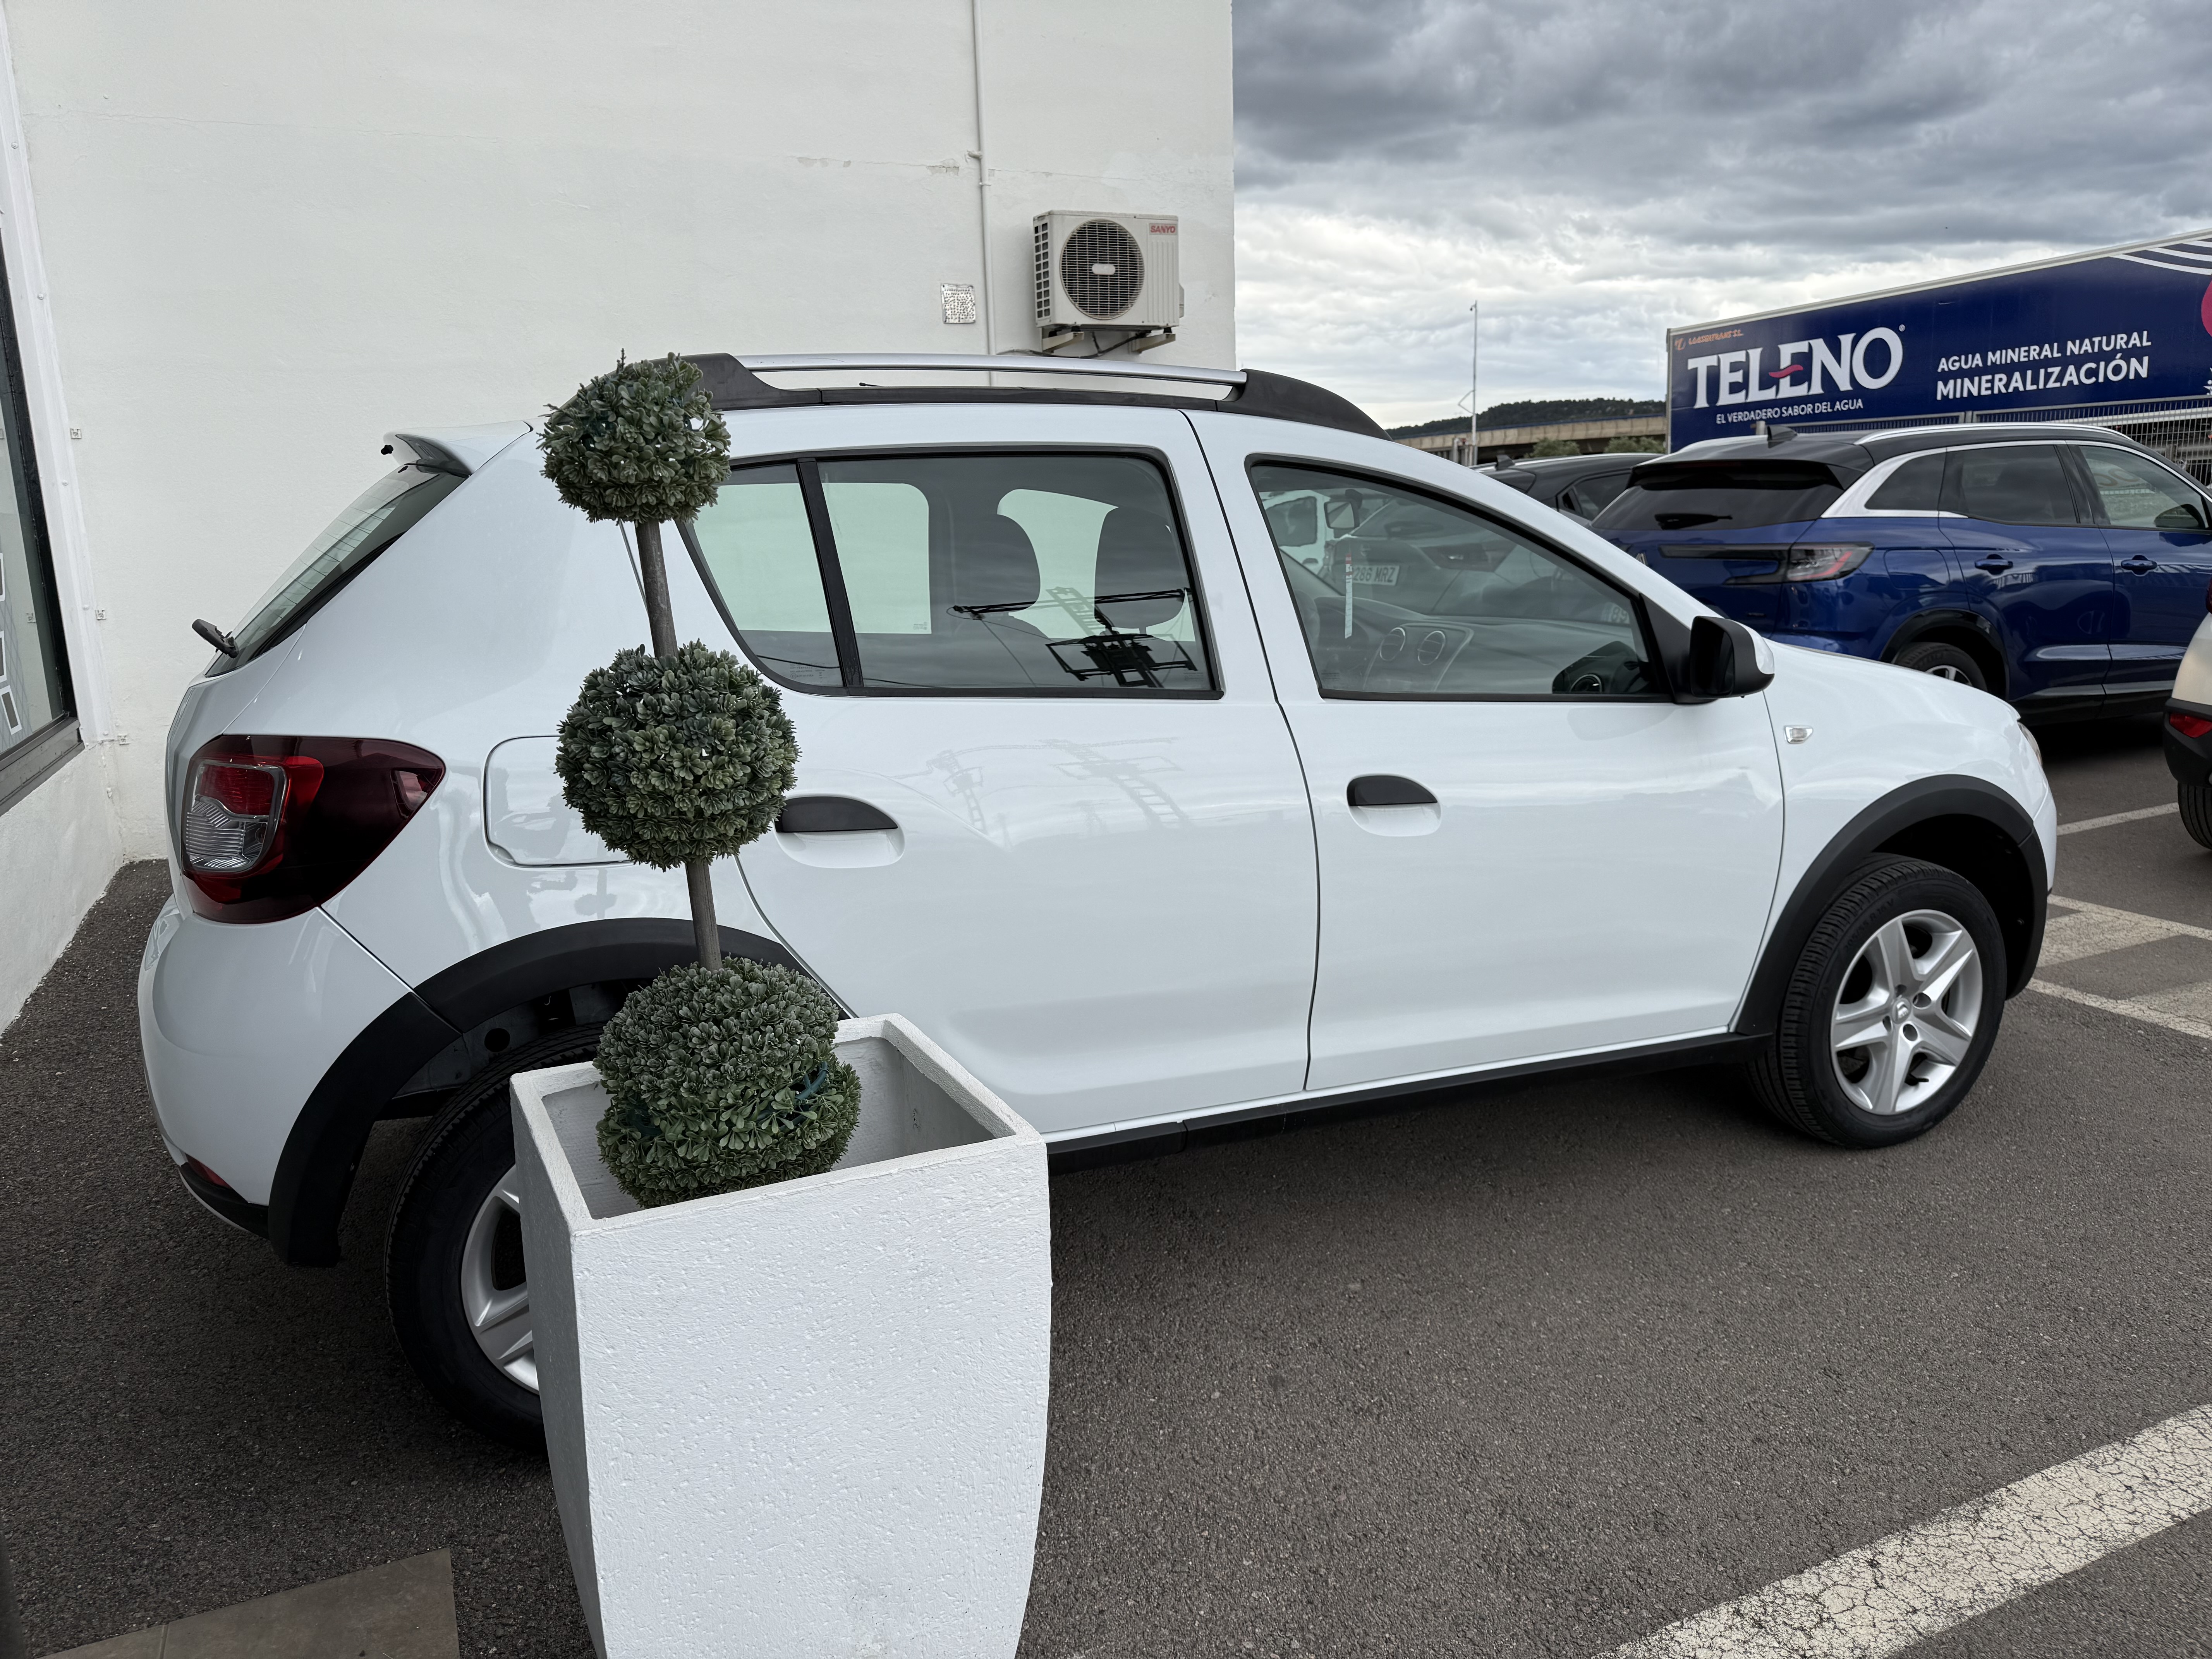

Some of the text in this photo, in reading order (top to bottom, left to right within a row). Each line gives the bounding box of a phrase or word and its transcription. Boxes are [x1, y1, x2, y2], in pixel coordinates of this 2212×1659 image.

[1687, 327, 1903, 409] TELENO
[1937, 330, 2152, 372] AGUA MINERAL NATURAL
[1937, 353, 2148, 400] MINERALIZACIÓN
[1716, 398, 1863, 424] EL VERDADERO SABOR DEL AGUA
[1351, 567, 1372, 582] 286
